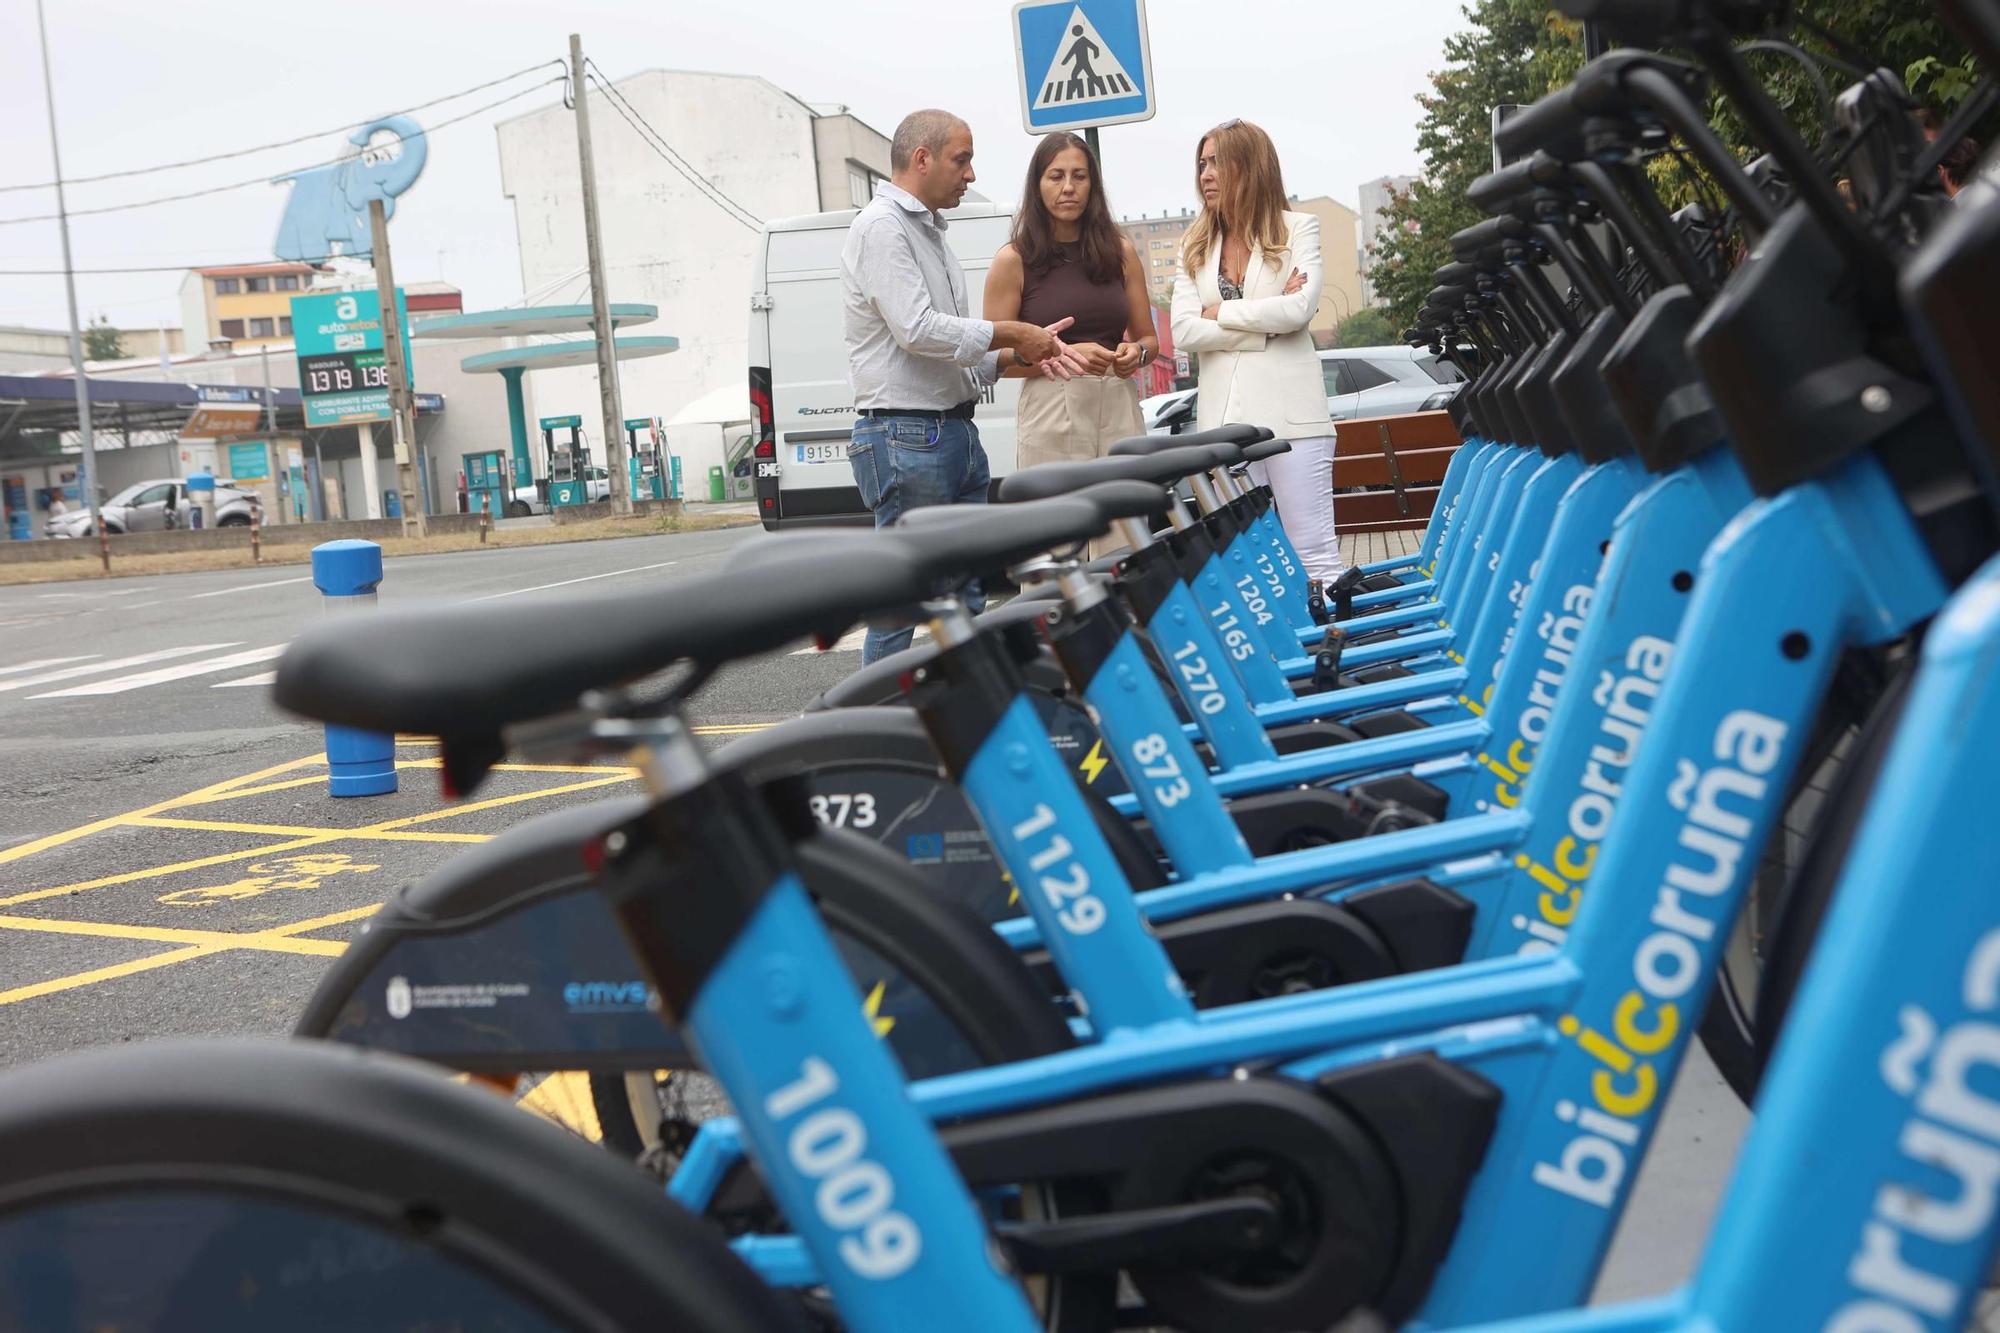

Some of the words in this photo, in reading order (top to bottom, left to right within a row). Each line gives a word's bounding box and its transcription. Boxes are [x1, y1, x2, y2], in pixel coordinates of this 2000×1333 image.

[802, 406, 856, 416] DUCAT
[807, 445, 840, 460] 9151
[1210, 600, 1256, 661] 1165
[1236, 574, 1274, 626] 1204
[1173, 640, 1227, 715] 1270
[1131, 732, 1192, 808] 873
[1011, 801, 1107, 936] 1129
[764, 1053, 923, 1281] 1009
